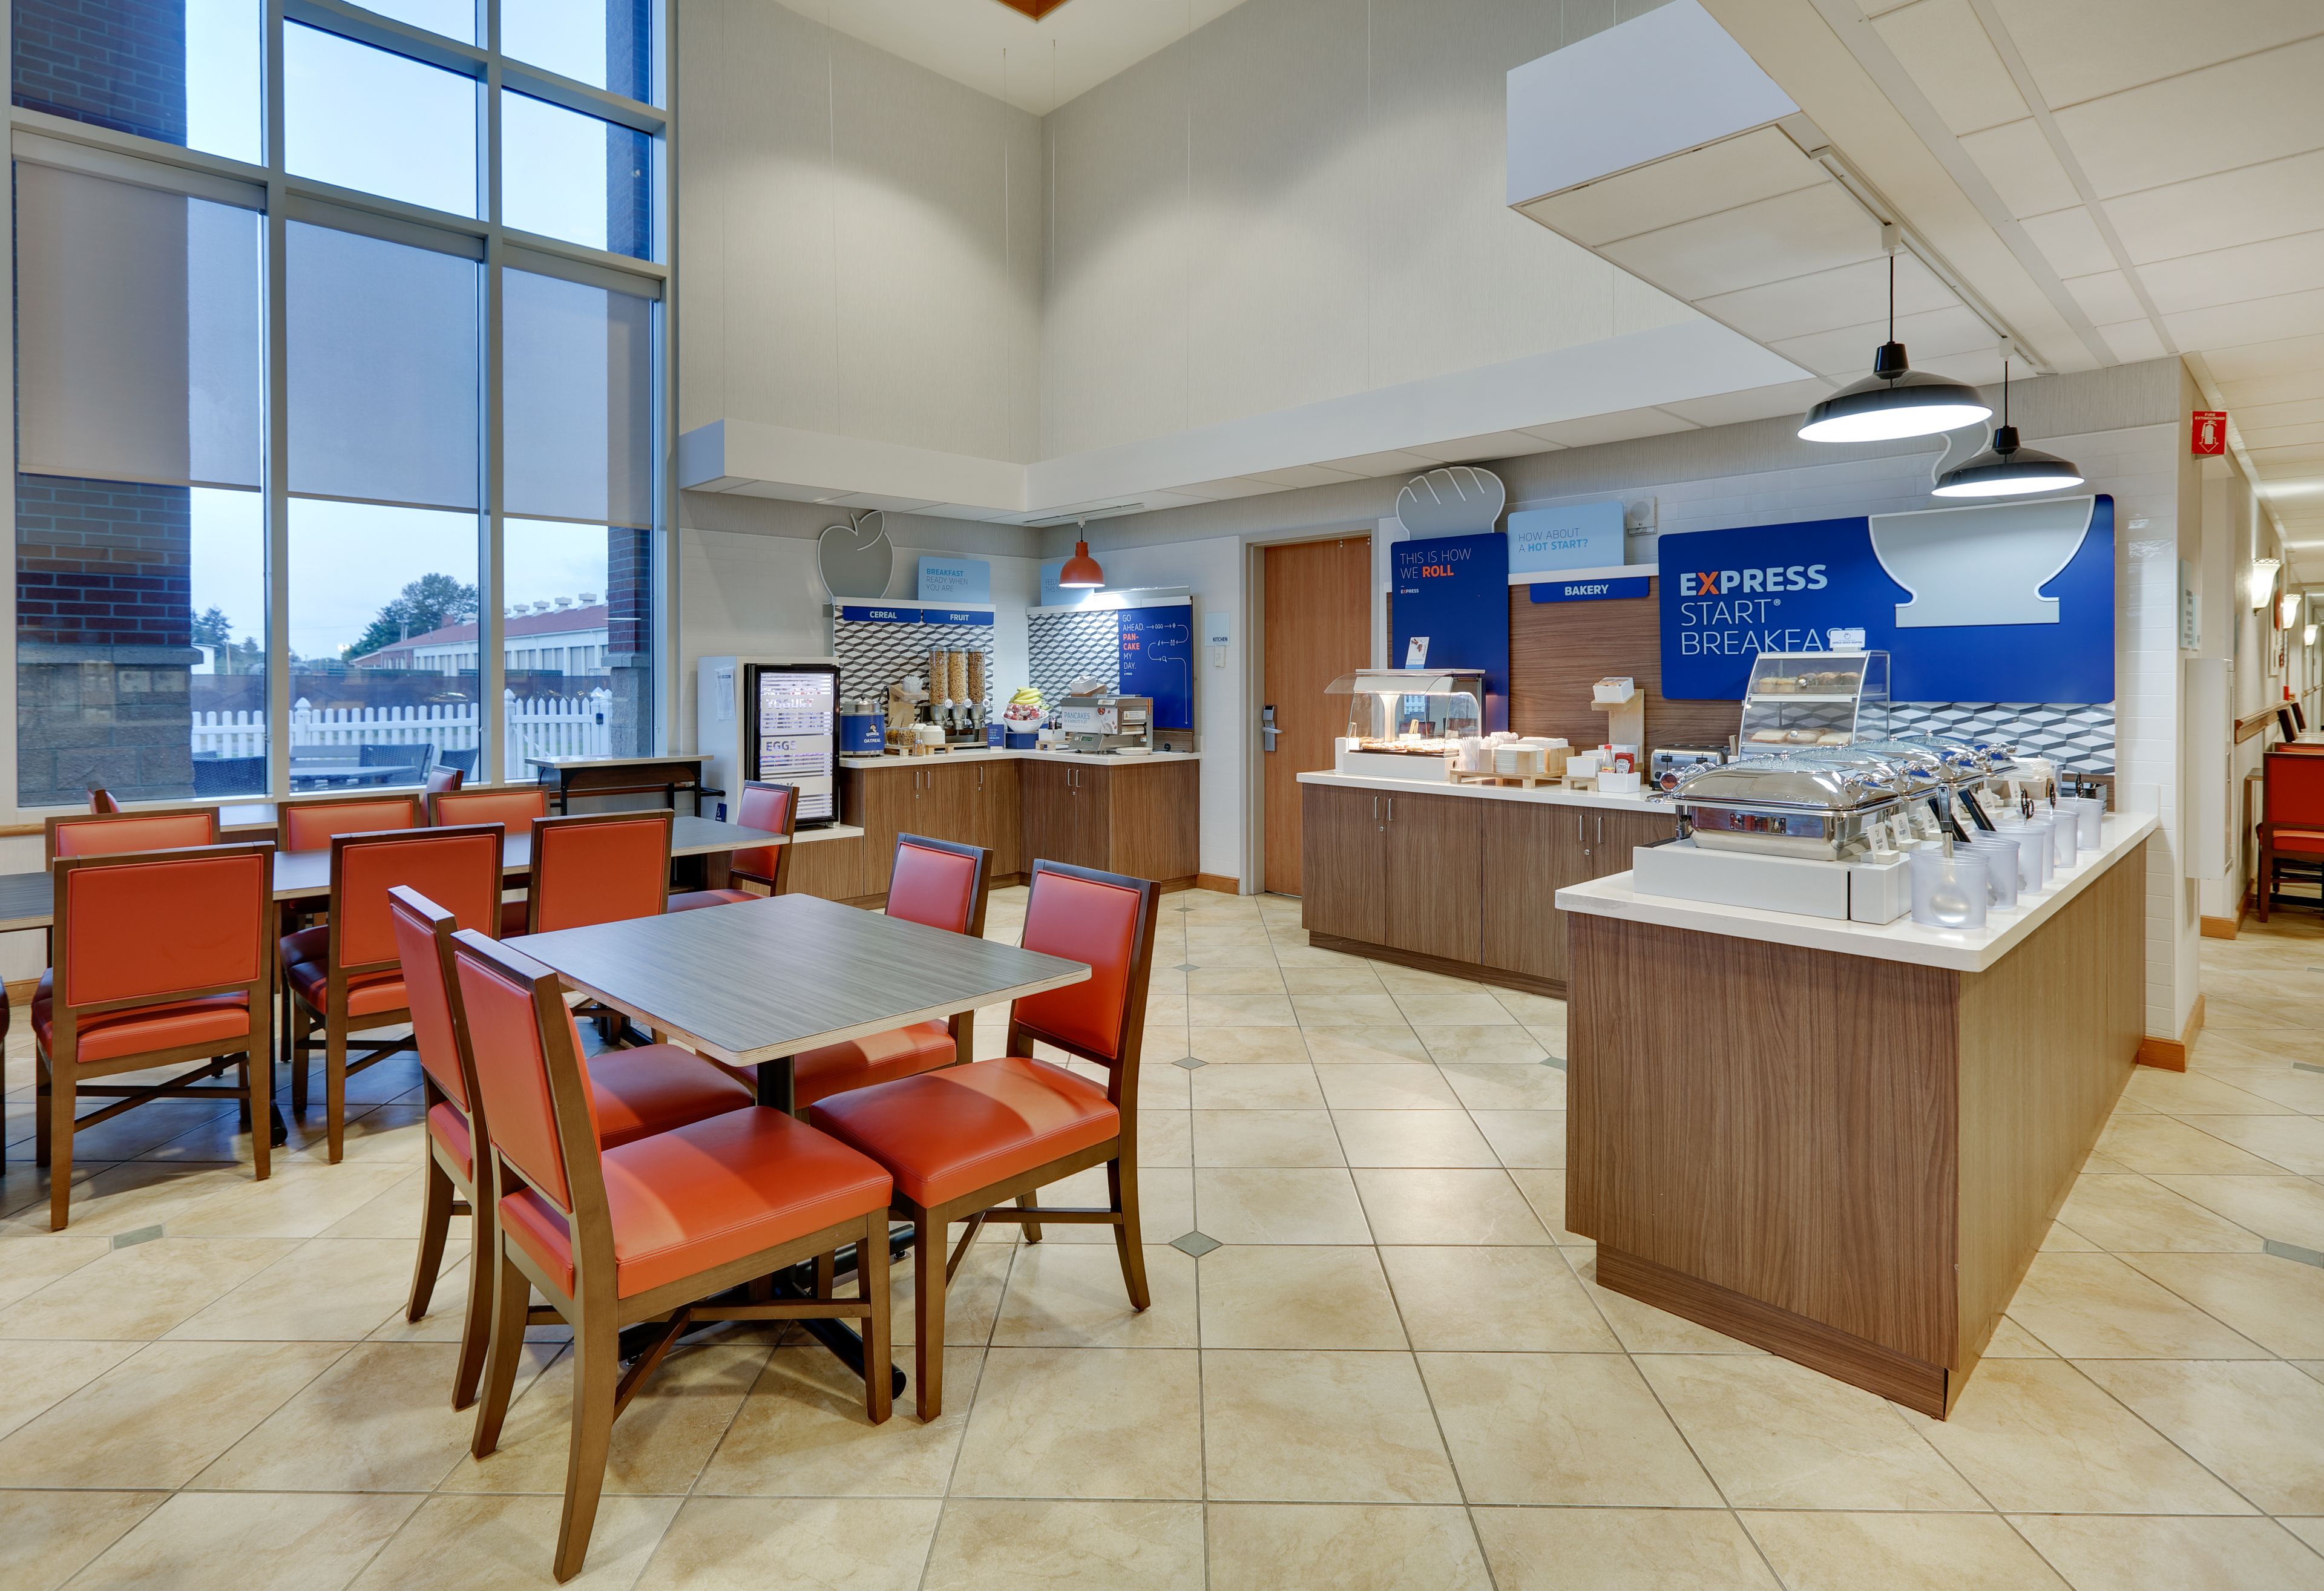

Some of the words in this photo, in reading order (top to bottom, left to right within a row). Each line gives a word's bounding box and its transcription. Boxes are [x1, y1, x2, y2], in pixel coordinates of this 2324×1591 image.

[1518, 531, 1543, 542] HOW
[1546, 528, 1580, 540] ABOUT
[1518, 544, 1525, 553] A
[1528, 542, 1548, 553] HOT
[1551, 539, 1589, 550] START?
[1400, 552, 1424, 565] THIS
[1428, 551, 1437, 563] IS
[1442, 548, 1471, 562] HOW
[926, 568, 964, 577] BREAKFAST
[1400, 566, 1419, 579] WE
[1422, 564, 1454, 577] ROLL
[926, 576, 947, 585] READY
[949, 577, 968, 585] WHEN
[1680, 564, 1828, 596] EXPRESS
[1564, 584, 1609, 596] BAKERY
[869, 611, 897, 620] CEREAL
[1681, 627, 1865, 655] BREAKFA
[766, 698, 814, 709] YOGURT
[766, 740, 796, 752] EGGS
